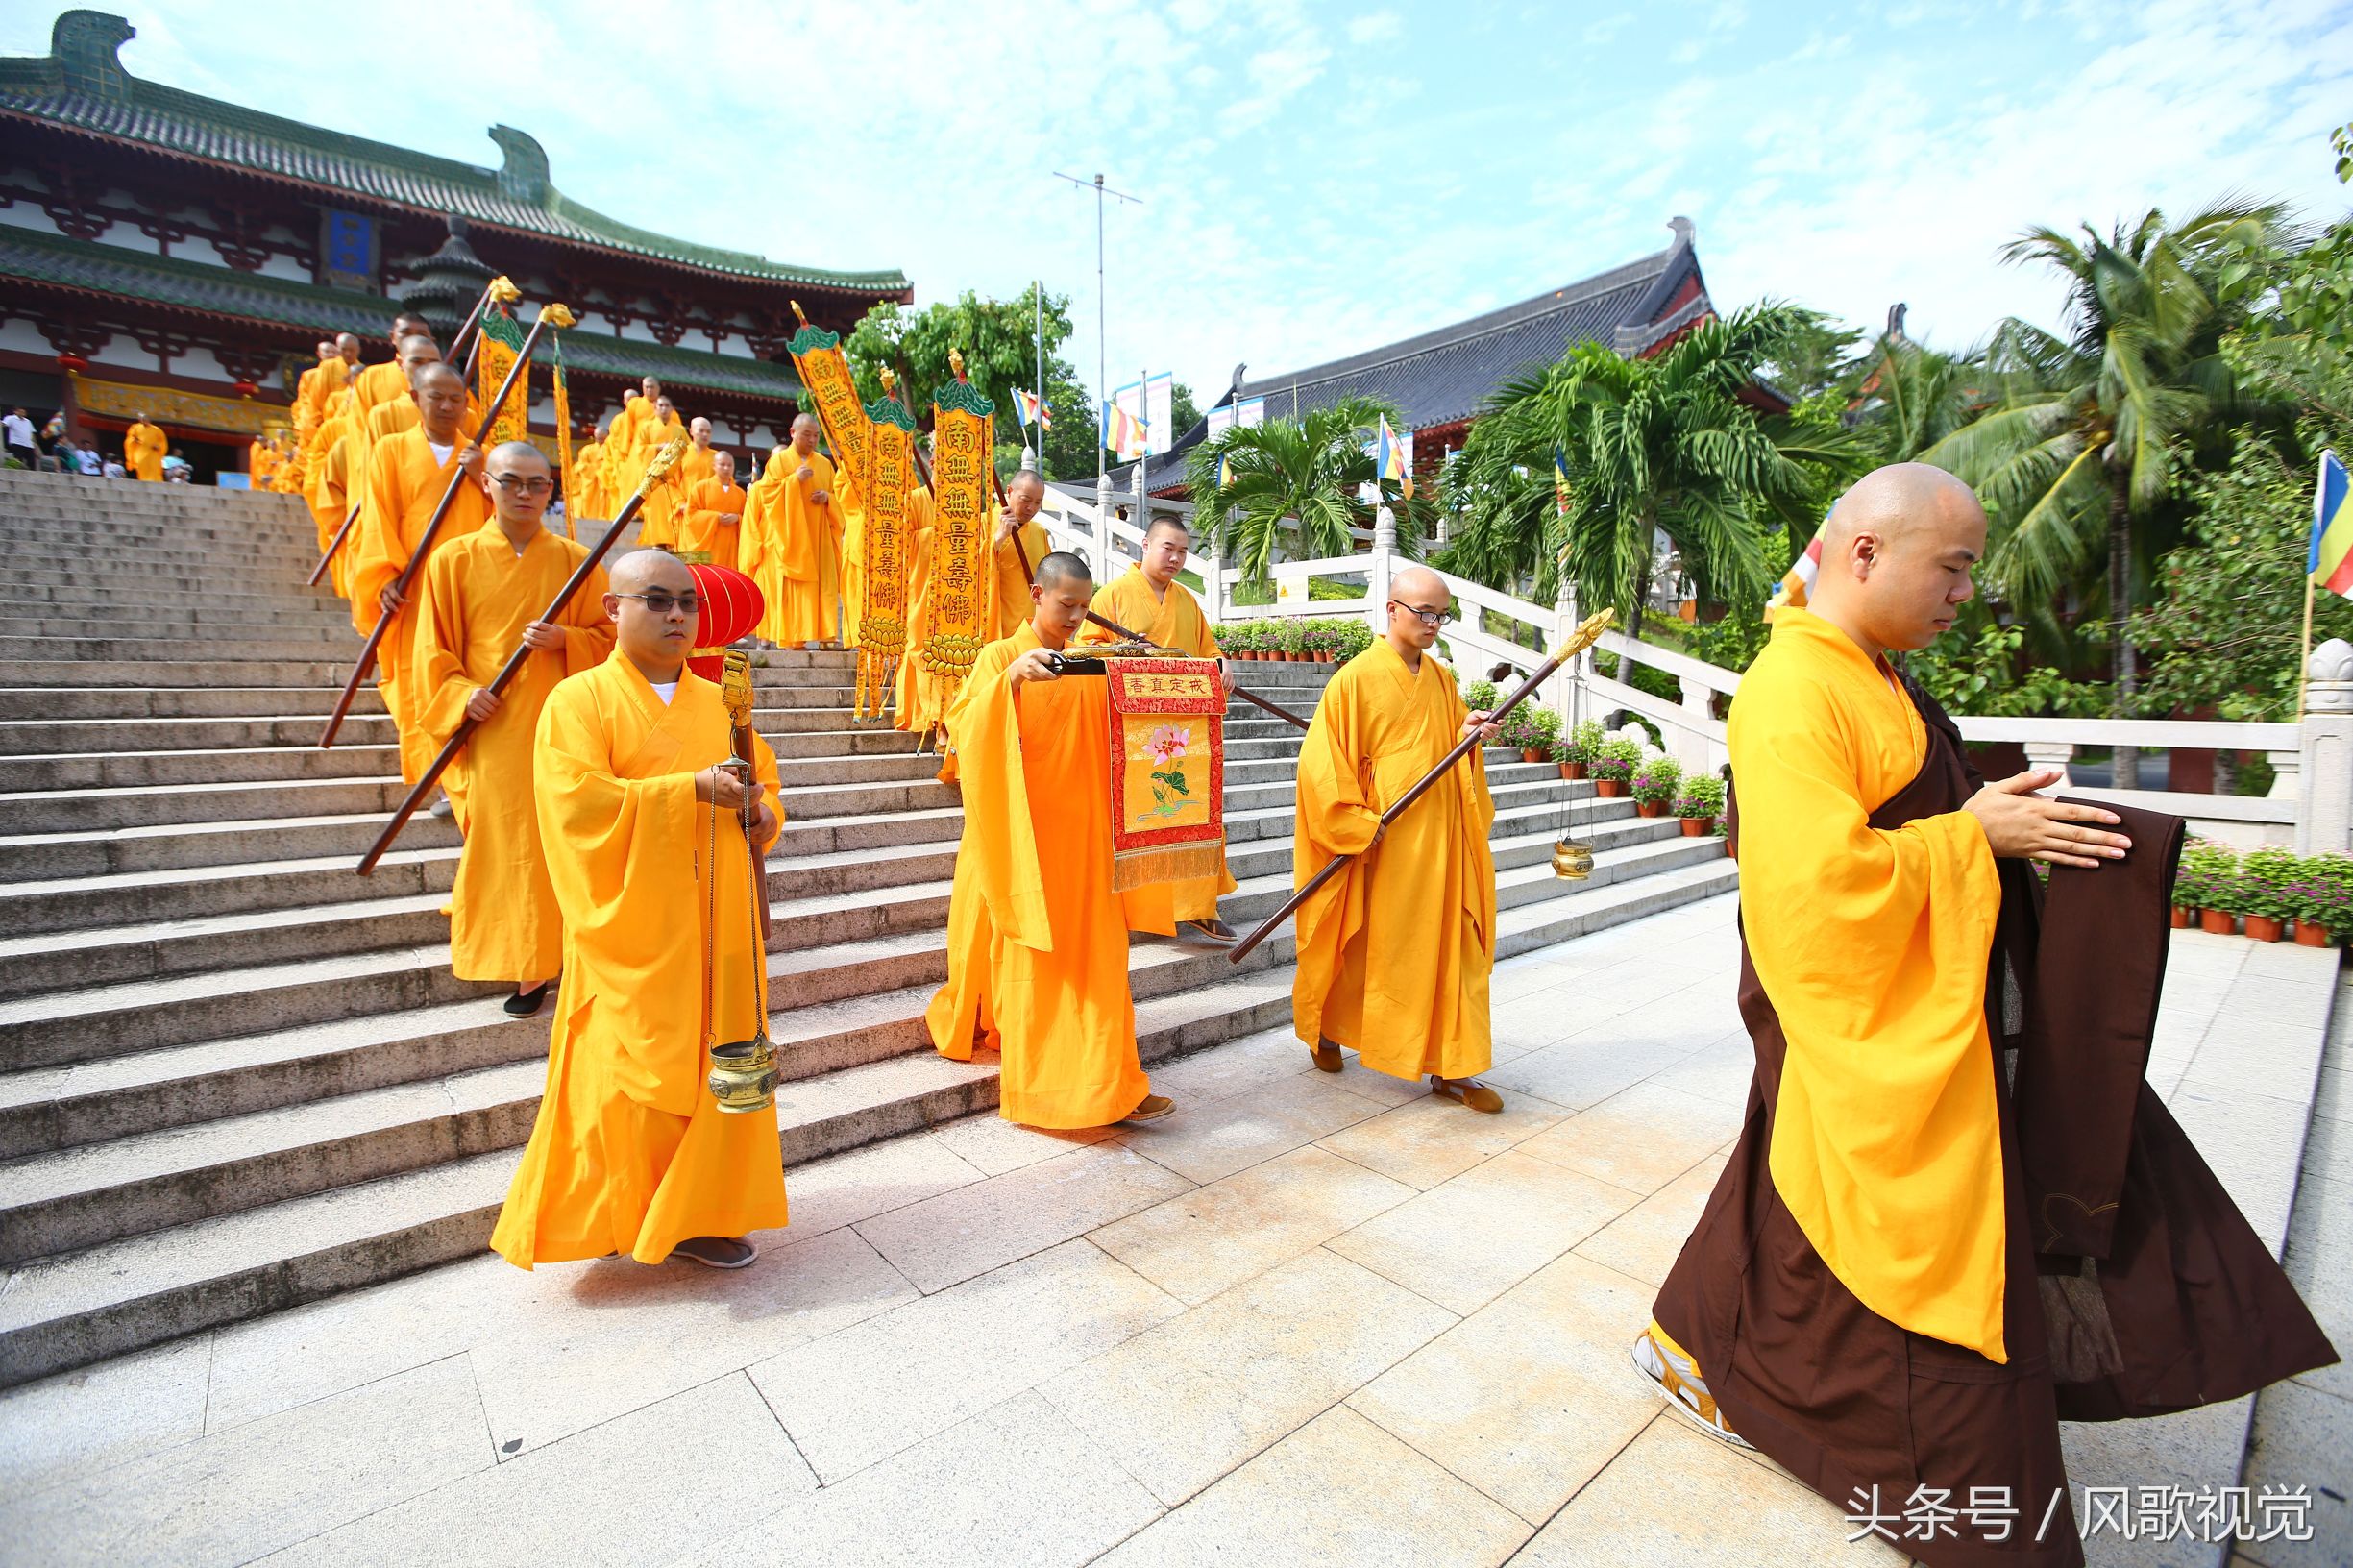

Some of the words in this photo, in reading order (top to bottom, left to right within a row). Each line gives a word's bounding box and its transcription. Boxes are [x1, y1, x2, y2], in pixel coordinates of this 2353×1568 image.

[874, 431, 902, 610] 南無無量壽佛
[942, 419, 976, 625] 南無無量壽佛
